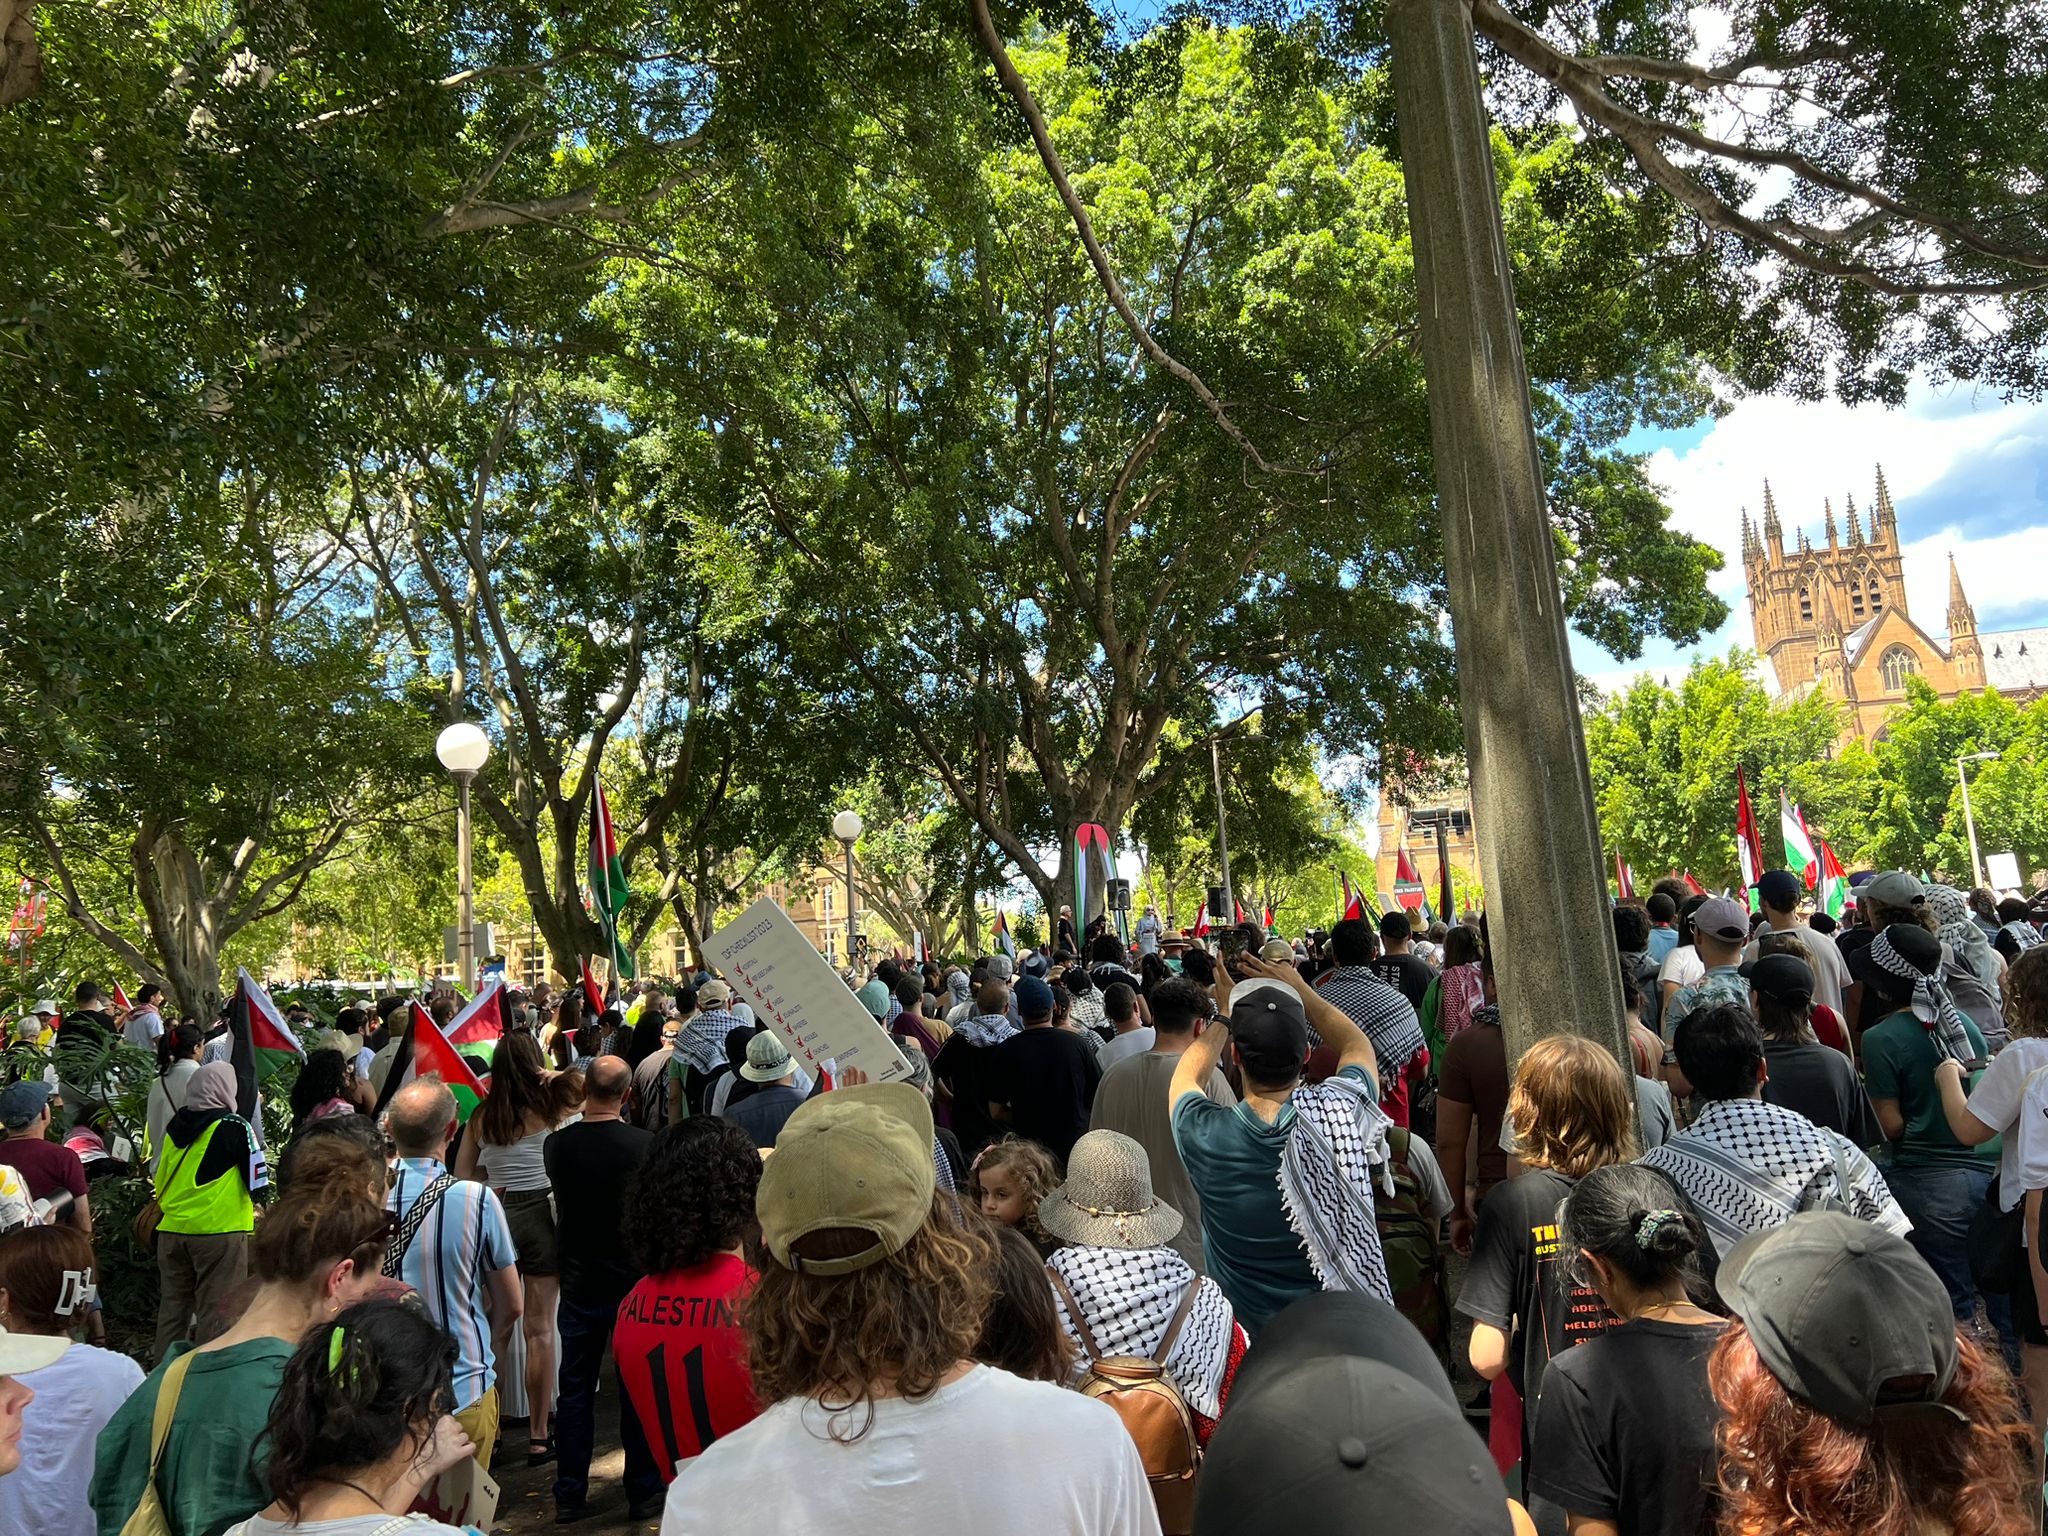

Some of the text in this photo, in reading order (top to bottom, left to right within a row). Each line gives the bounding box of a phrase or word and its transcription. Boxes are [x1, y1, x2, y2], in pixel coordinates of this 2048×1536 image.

[721, 918, 773, 960] IDF CHECKLIST 2023
[647, 1342, 717, 1475] 11
